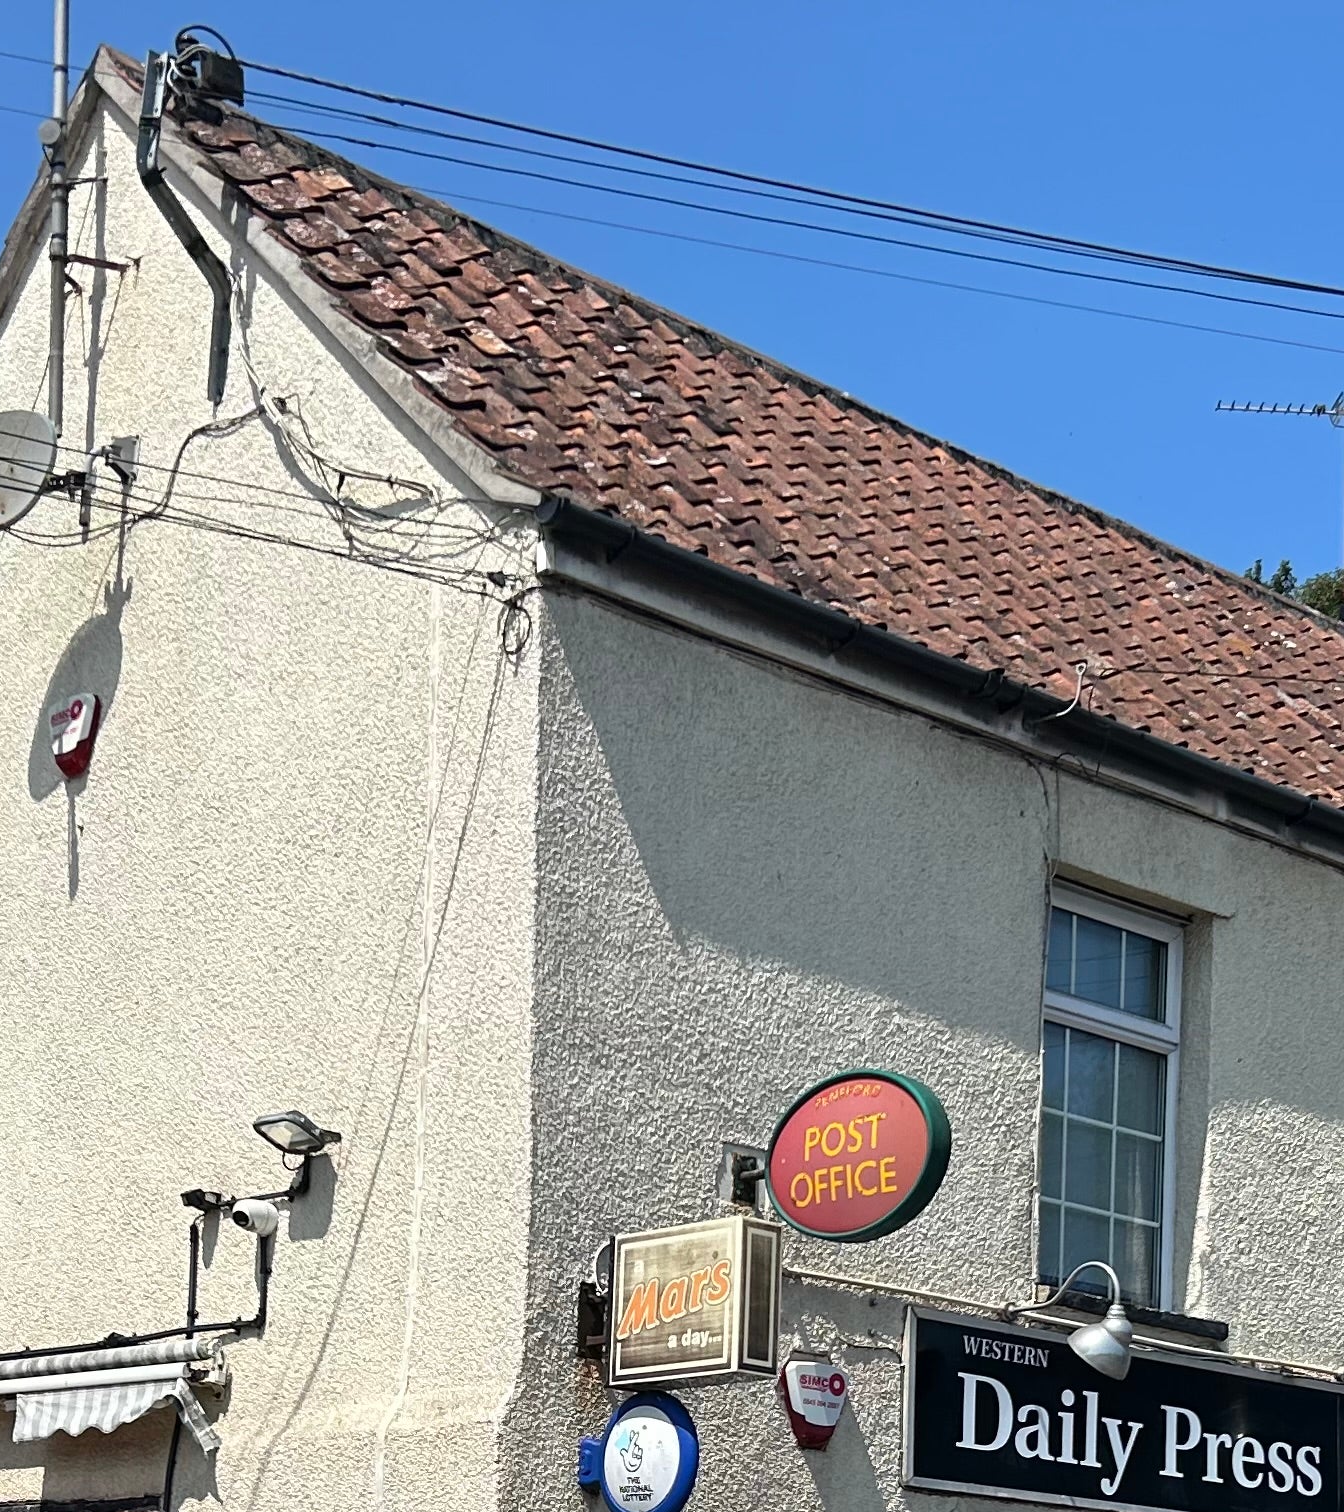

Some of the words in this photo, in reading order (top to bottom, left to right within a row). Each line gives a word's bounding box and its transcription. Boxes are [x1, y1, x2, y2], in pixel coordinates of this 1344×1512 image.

[804, 1112, 887, 1161] POST
[790, 1156, 897, 1208] OFFICE
[616, 1259, 731, 1340] Mars
[667, 1334, 677, 1348] a
[963, 1334, 1050, 1368] WESTERN
[956, 1372, 1144, 1496] Daily
[1159, 1404, 1323, 1497] Press
